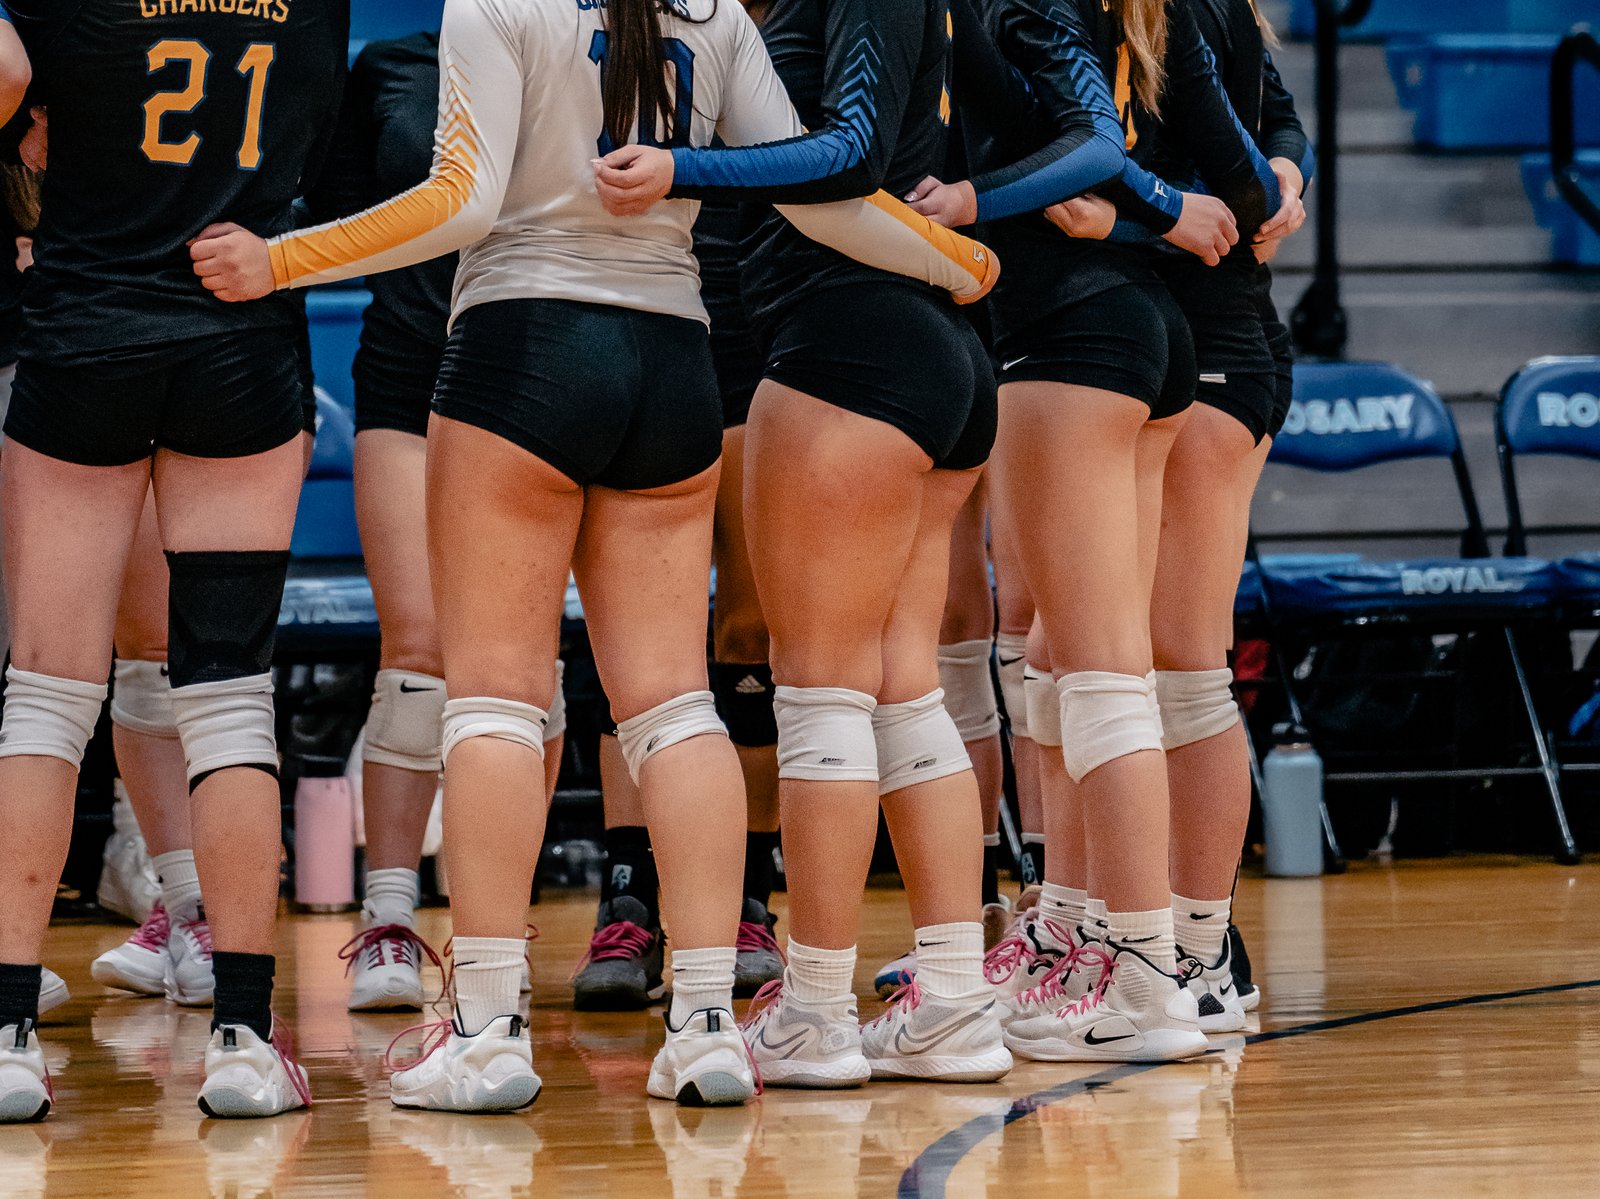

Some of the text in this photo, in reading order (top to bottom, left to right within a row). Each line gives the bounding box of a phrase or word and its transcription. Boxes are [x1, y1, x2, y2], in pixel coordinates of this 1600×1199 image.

[140, 37, 276, 171] 21
[1282, 393, 1416, 436] OSARY
[1536, 392, 1600, 428] RO
[1401, 567, 1512, 596] ROYAL
